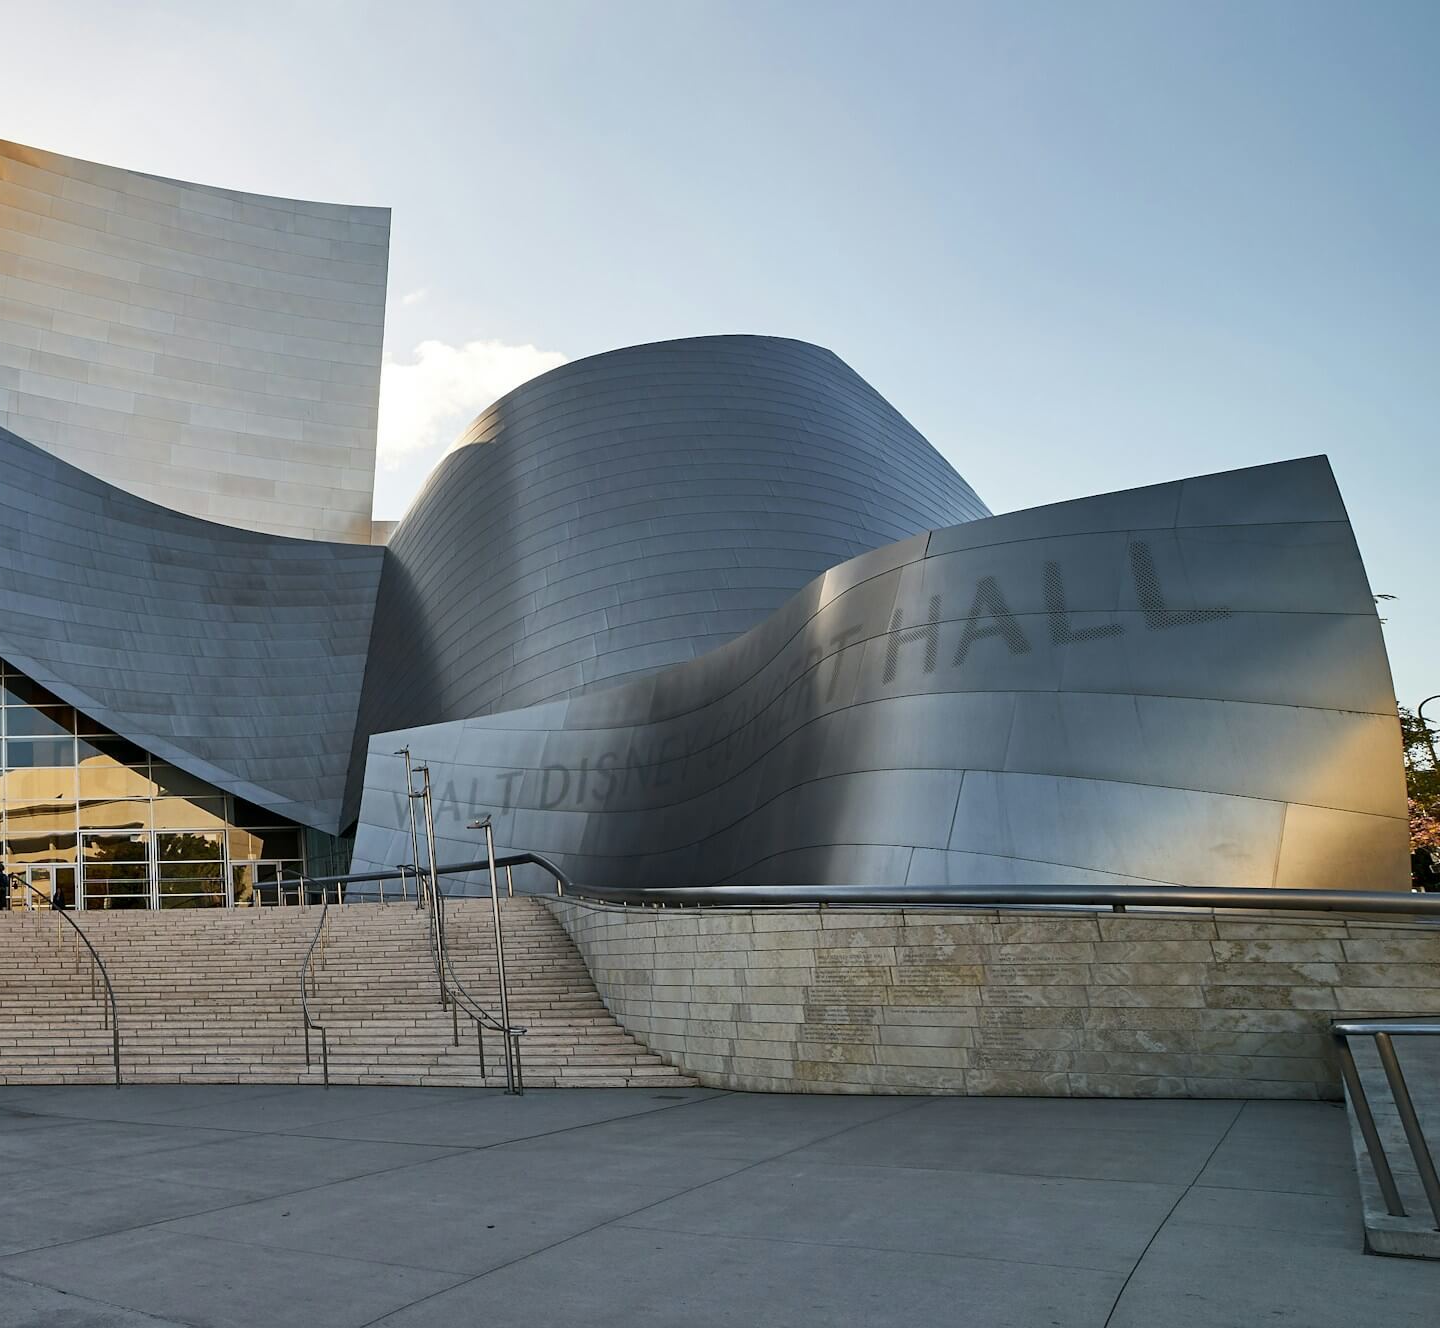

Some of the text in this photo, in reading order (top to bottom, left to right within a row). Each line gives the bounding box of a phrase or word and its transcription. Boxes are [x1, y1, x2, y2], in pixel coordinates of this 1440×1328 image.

[392, 770, 524, 829] WALT
[540, 722, 703, 809] DISNEY
[882, 541, 1233, 686] HALL
